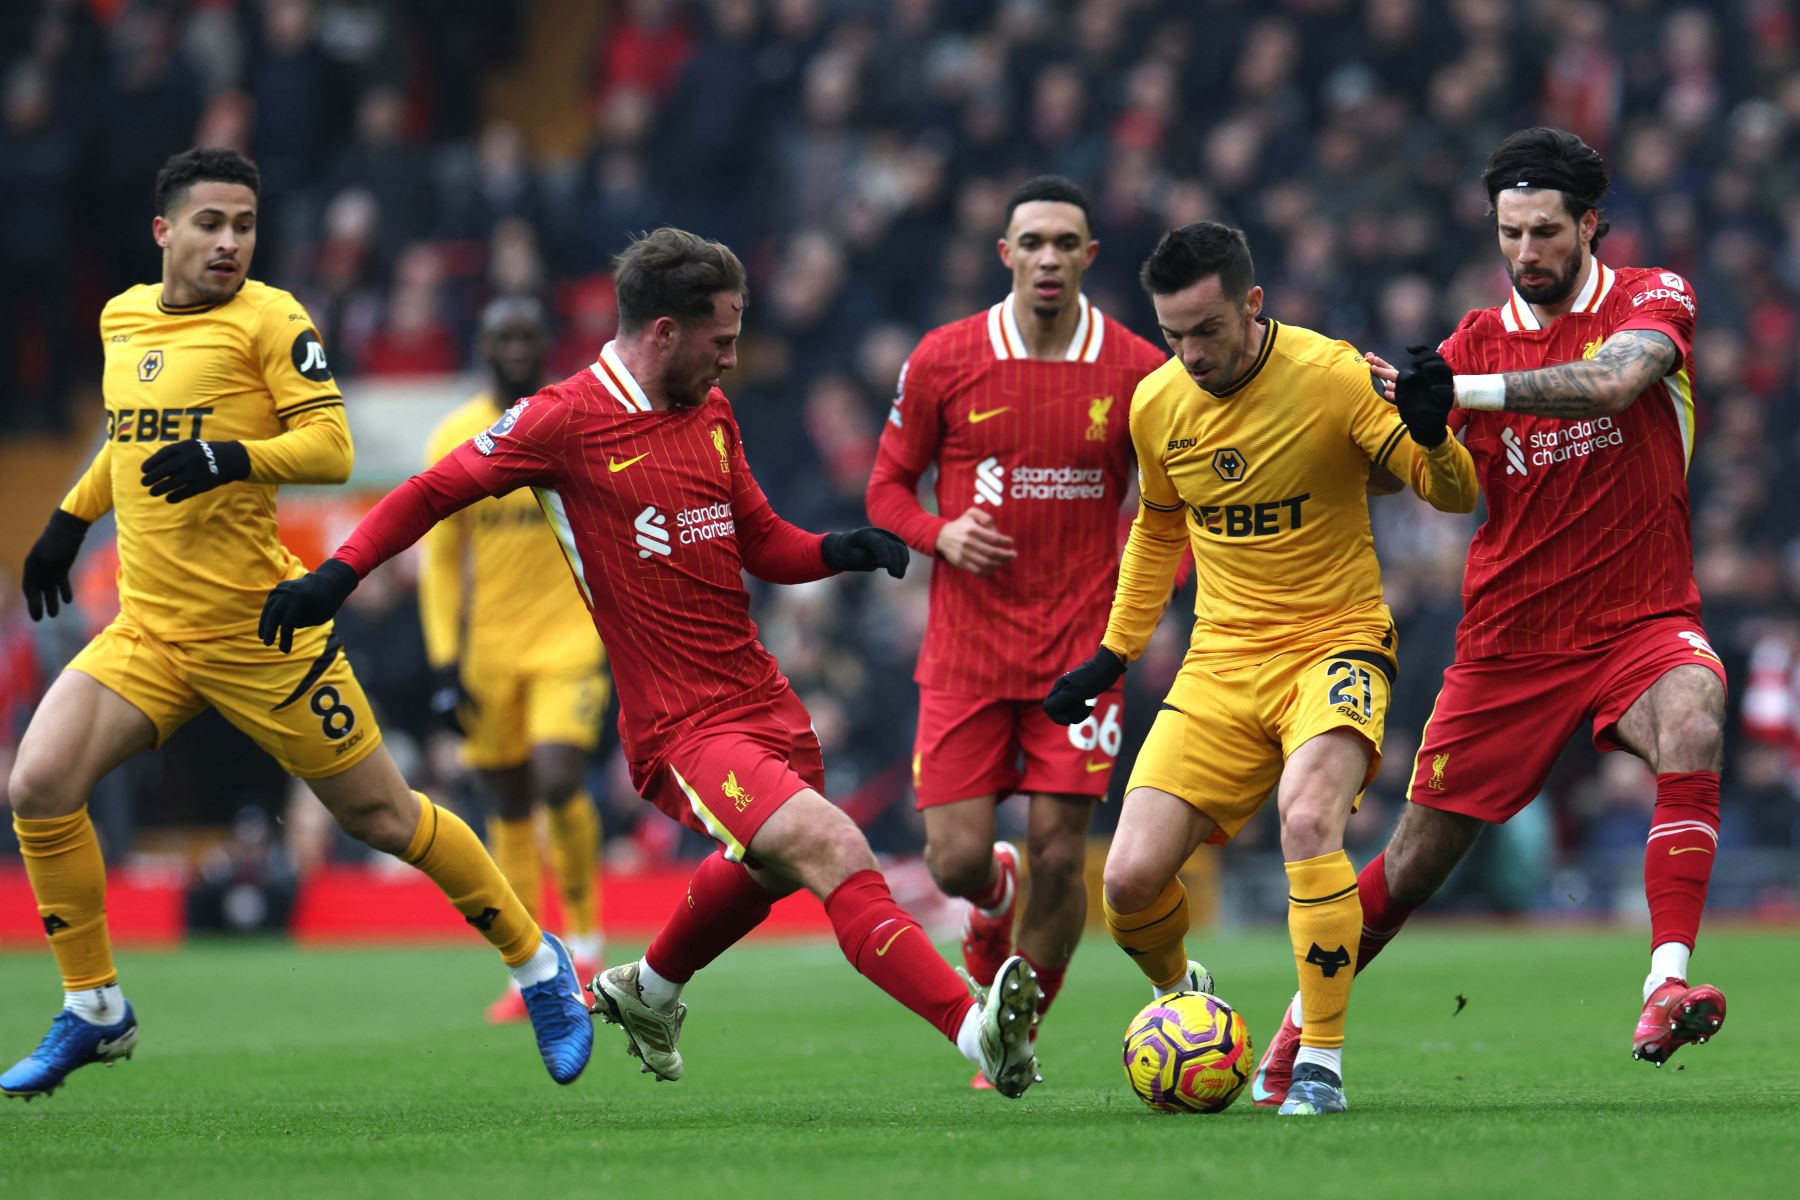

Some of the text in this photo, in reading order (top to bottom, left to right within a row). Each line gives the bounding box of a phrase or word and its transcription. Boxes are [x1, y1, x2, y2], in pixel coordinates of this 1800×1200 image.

[1167, 437, 1198, 451] SUDU
[1532, 428, 1623, 466] chartered
[1011, 464, 1104, 483] standard
[1010, 480, 1105, 500] chartered
[676, 501, 733, 527] standar
[680, 520, 736, 545] chartere
[1326, 659, 1373, 720] 21
[309, 683, 356, 741] 8
[1335, 705, 1368, 726] SUDU
[1067, 697, 1122, 758] 66
[335, 728, 364, 757] SUDU
[1428, 779, 1446, 791] LFC
[735, 794, 755, 812] LFC
